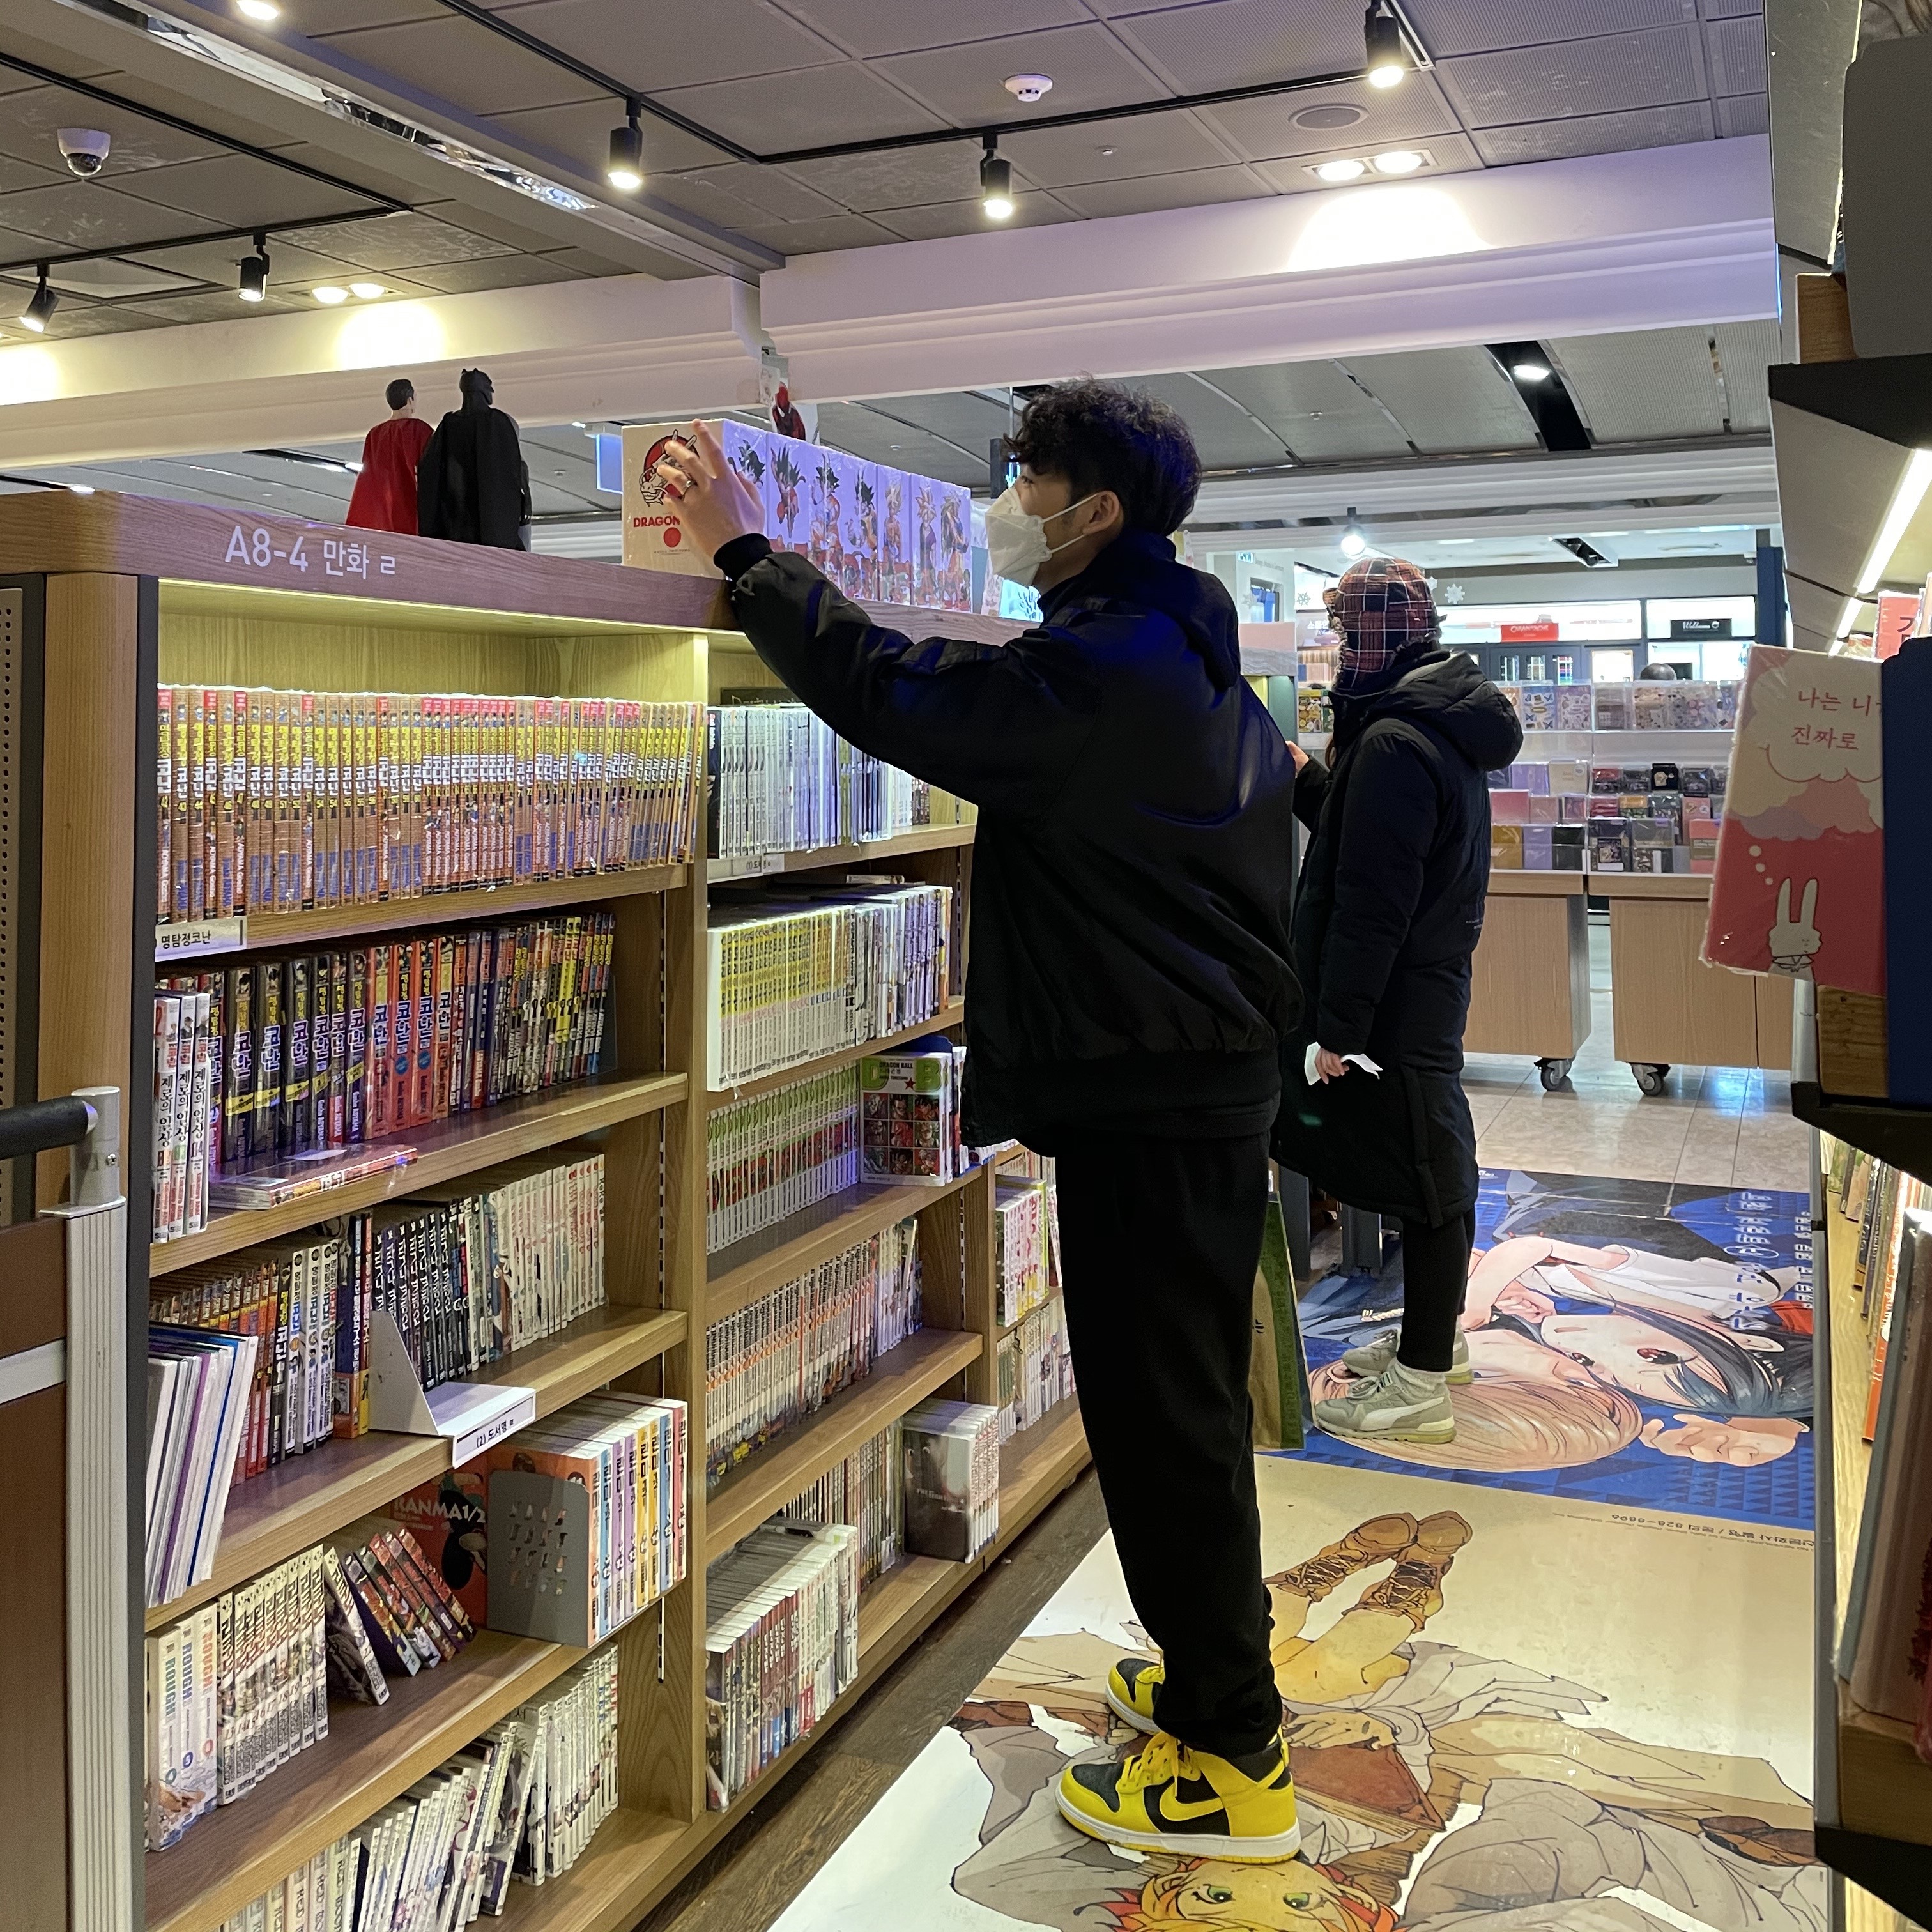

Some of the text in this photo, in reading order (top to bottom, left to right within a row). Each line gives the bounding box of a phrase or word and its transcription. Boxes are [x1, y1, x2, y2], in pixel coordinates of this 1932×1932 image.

[634, 516, 680, 527] DRAGON
[225, 525, 308, 572] A8-4
[323, 540, 369, 579] 만화
[1798, 687, 1881, 716] 나는 니
[1791, 724, 1858, 750] 진짜로
[279, 800, 287, 809] 51
[316, 799, 324, 808] 54
[161, 930, 211, 949] 명탐정코난
[158, 1075, 173, 1147] 제로의 일상
[175, 1070, 190, 1142] 제로의 일상
[192, 1067, 205, 1138] 제로의 일상
[488, 1420, 507, 1441] 도서명
[183, 1643, 192, 1699] ROUGH
[203, 1630, 213, 1689] ROUGH
[165, 1657, 176, 1716] ROUGH
